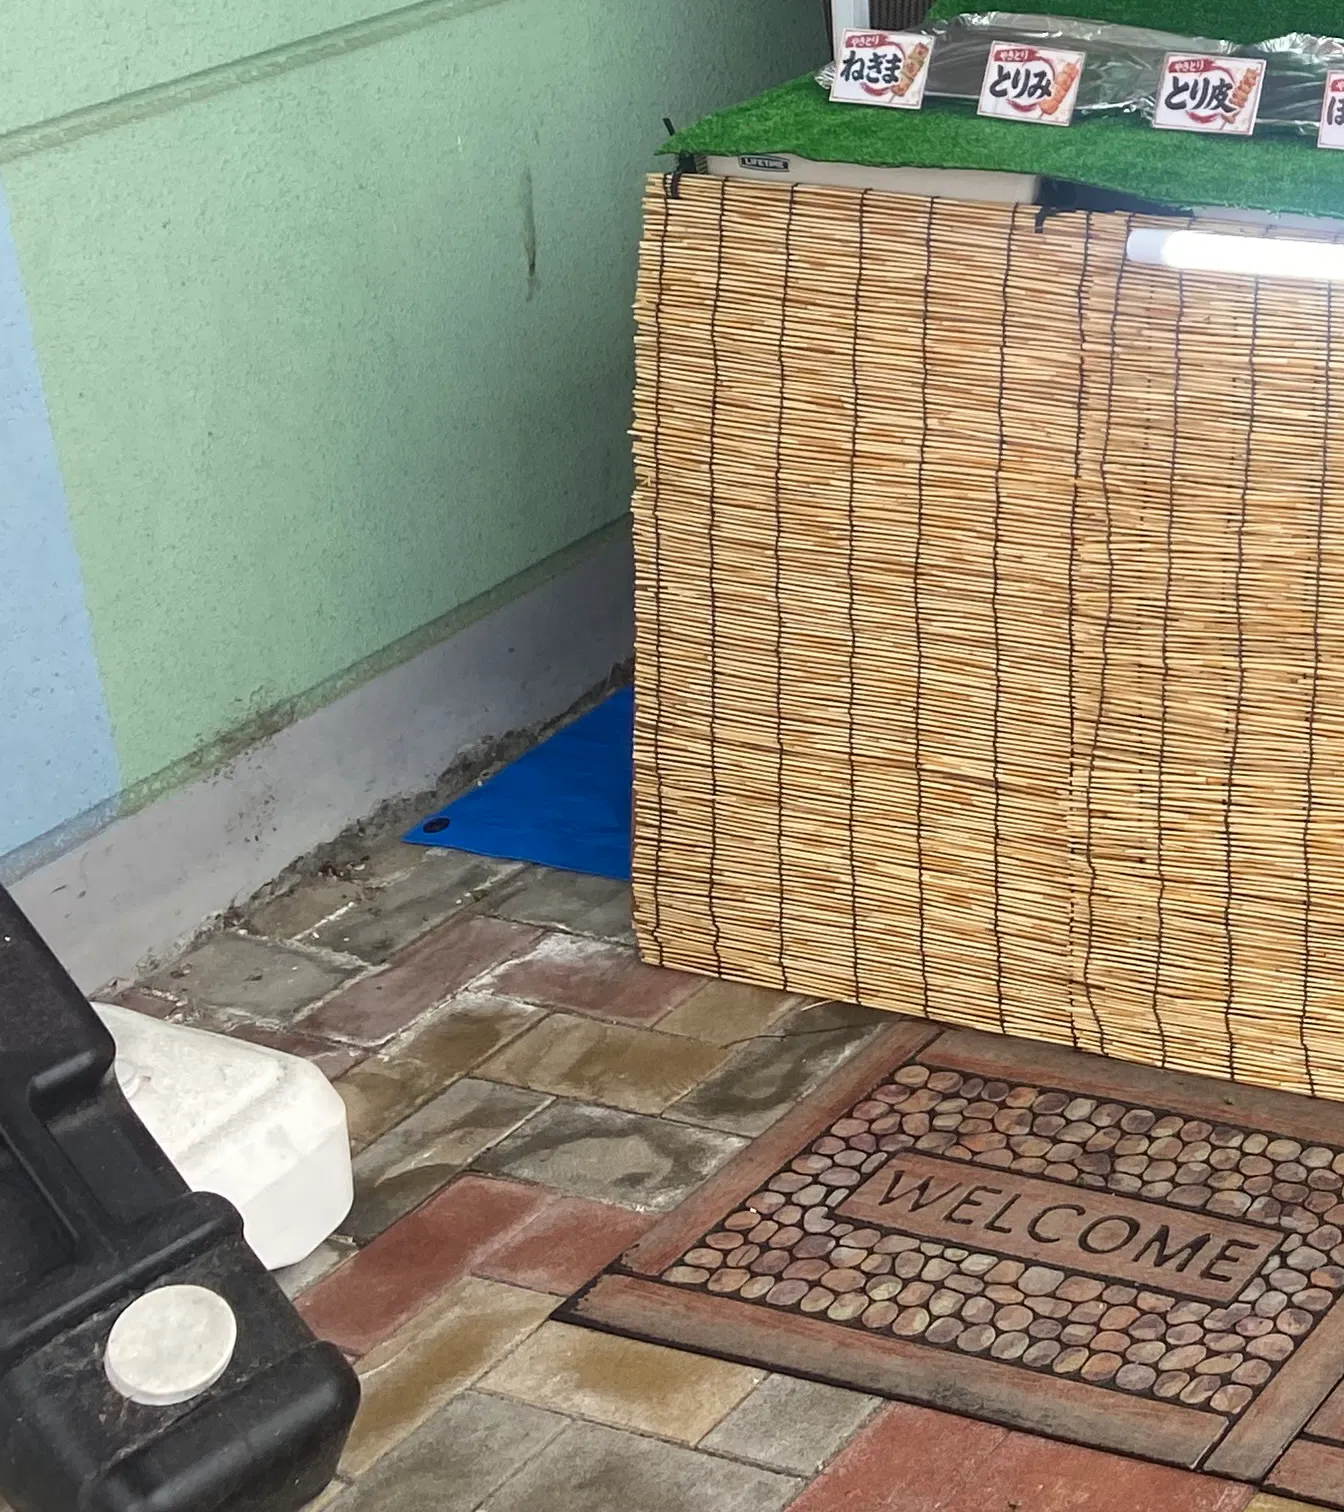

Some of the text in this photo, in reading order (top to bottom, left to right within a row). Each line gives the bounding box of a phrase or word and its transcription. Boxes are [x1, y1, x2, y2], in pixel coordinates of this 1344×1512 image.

[851, 35, 880, 48] やきとり
[999, 50, 1029, 63] やきとり
[841, 50, 903, 85] ねぎま
[990, 64, 1052, 100] とりみ
[1174, 60, 1205, 72] やきとり
[1165, 77, 1235, 113] とり皮
[877, 1169, 1260, 1283] WELCOME
